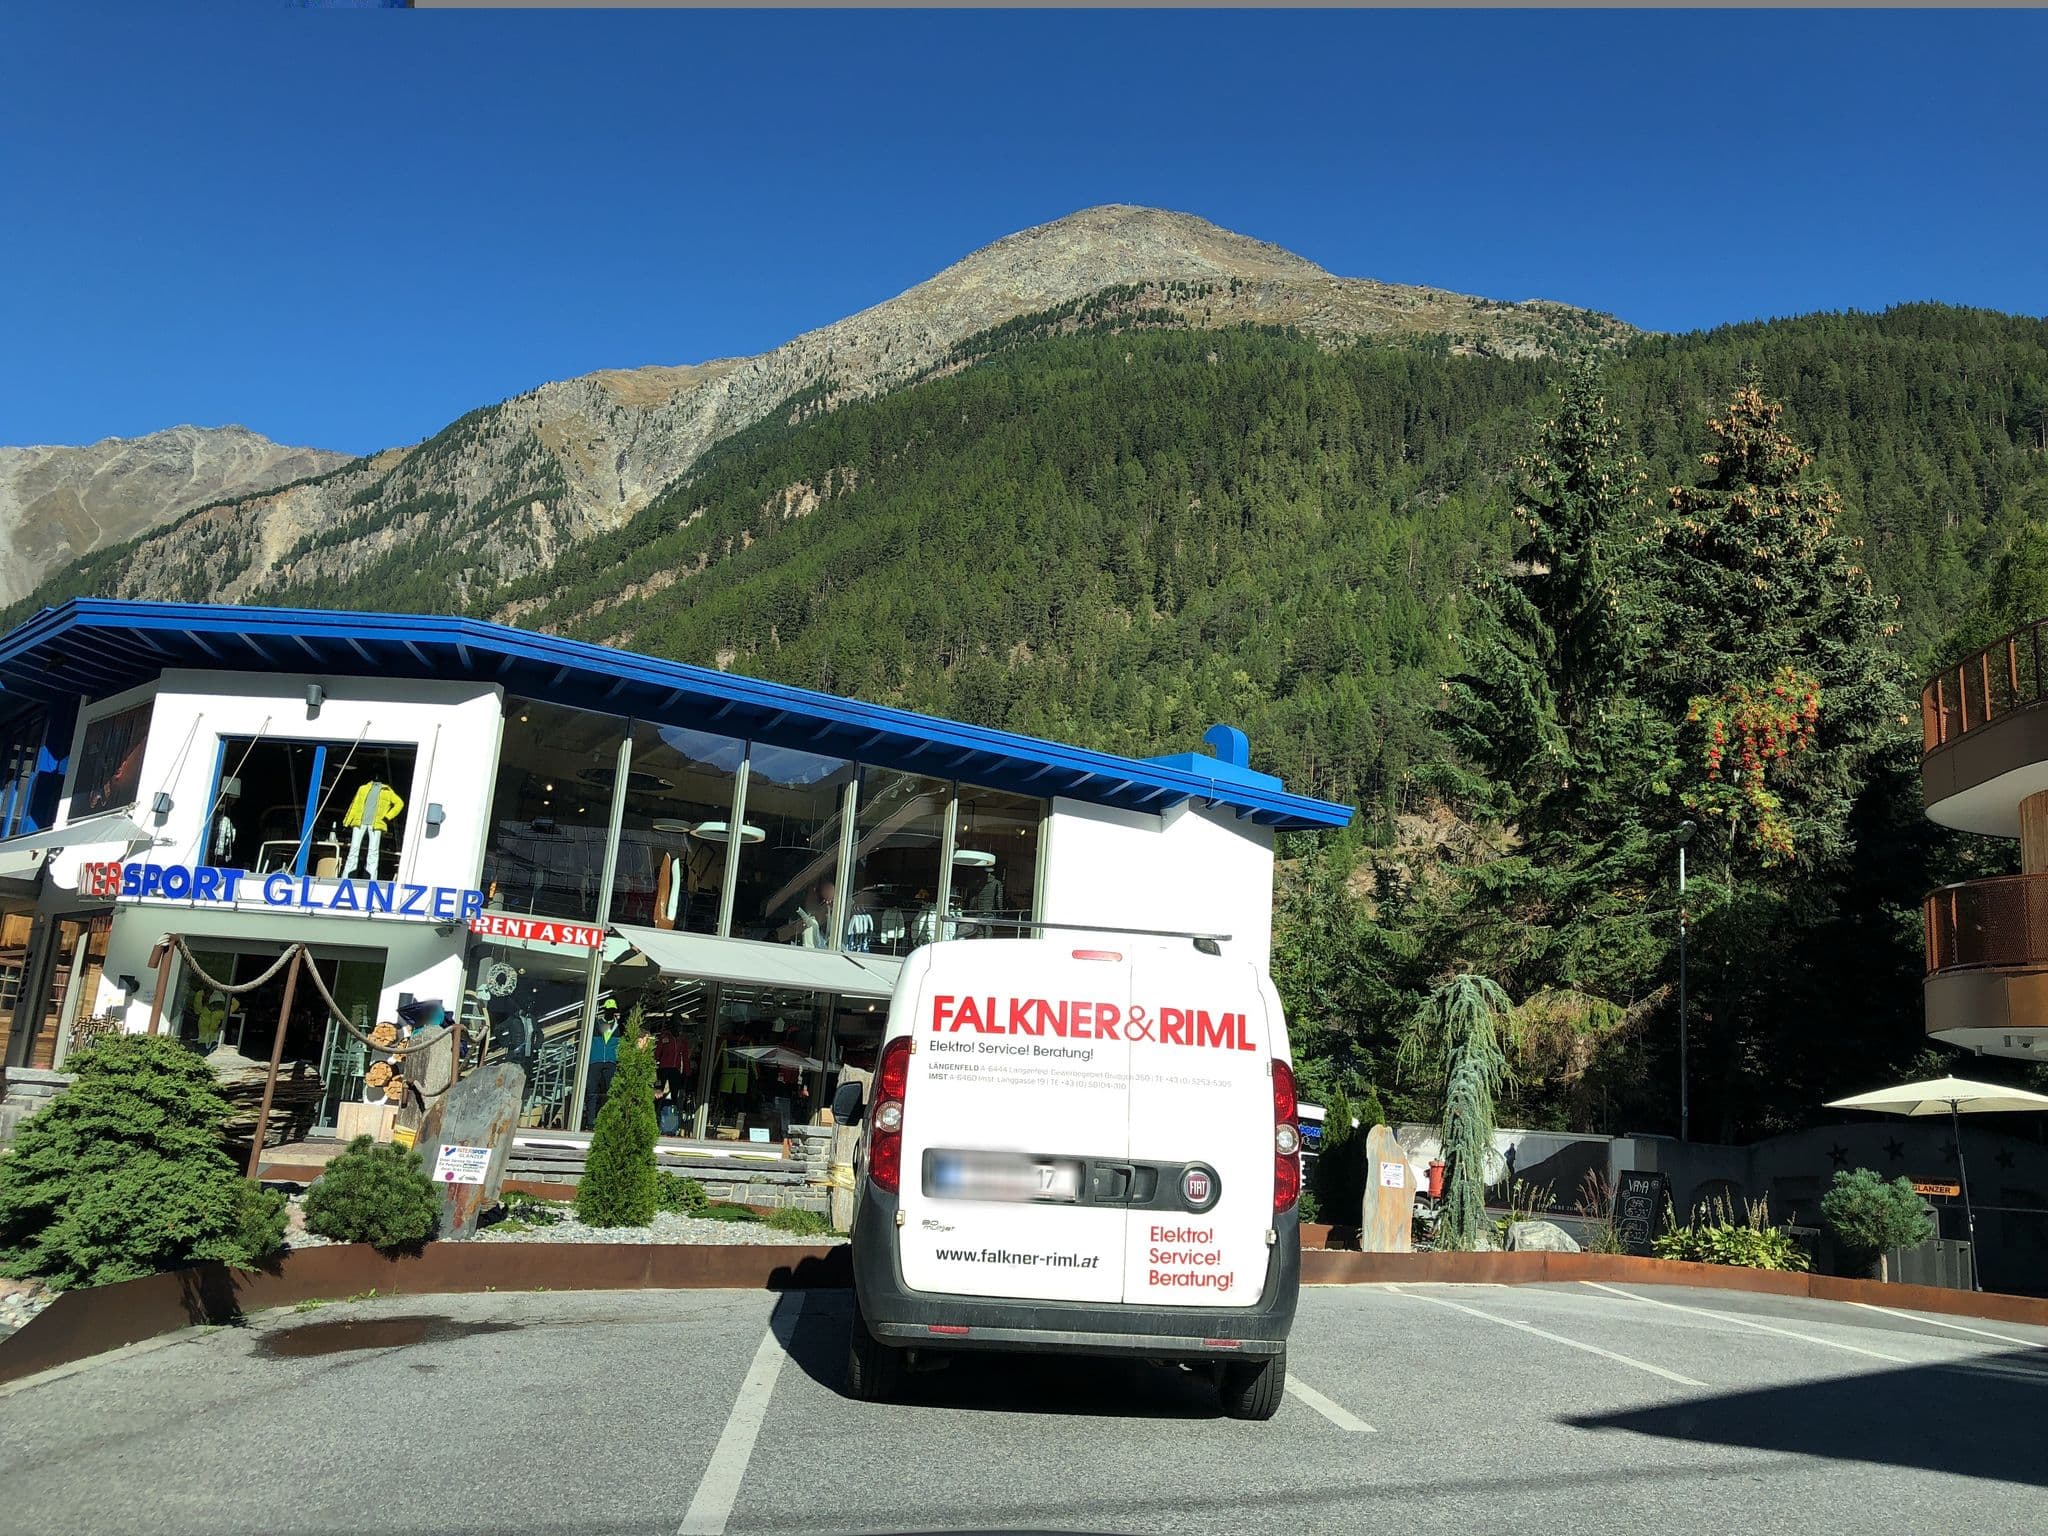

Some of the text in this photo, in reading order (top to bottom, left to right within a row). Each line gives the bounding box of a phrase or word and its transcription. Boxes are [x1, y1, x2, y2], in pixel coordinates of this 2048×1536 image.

[263, 872, 486, 920] GLANZER
[475, 916, 599, 945] RENT A SKI
[929, 1040, 1094, 1062] Elektro! Service! Beratung!
[928, 1061, 979, 1072] LÄNGENFELD
[928, 1072, 947, 1080] IMST
[1189, 1180, 1207, 1196] FIAT
[1150, 1226, 1213, 1244] Elektro!
[936, 1249, 1100, 1269] www.falkner-riml.at
[1149, 1247, 1221, 1265] Service!
[1149, 1269, 1234, 1291] Beratung!
